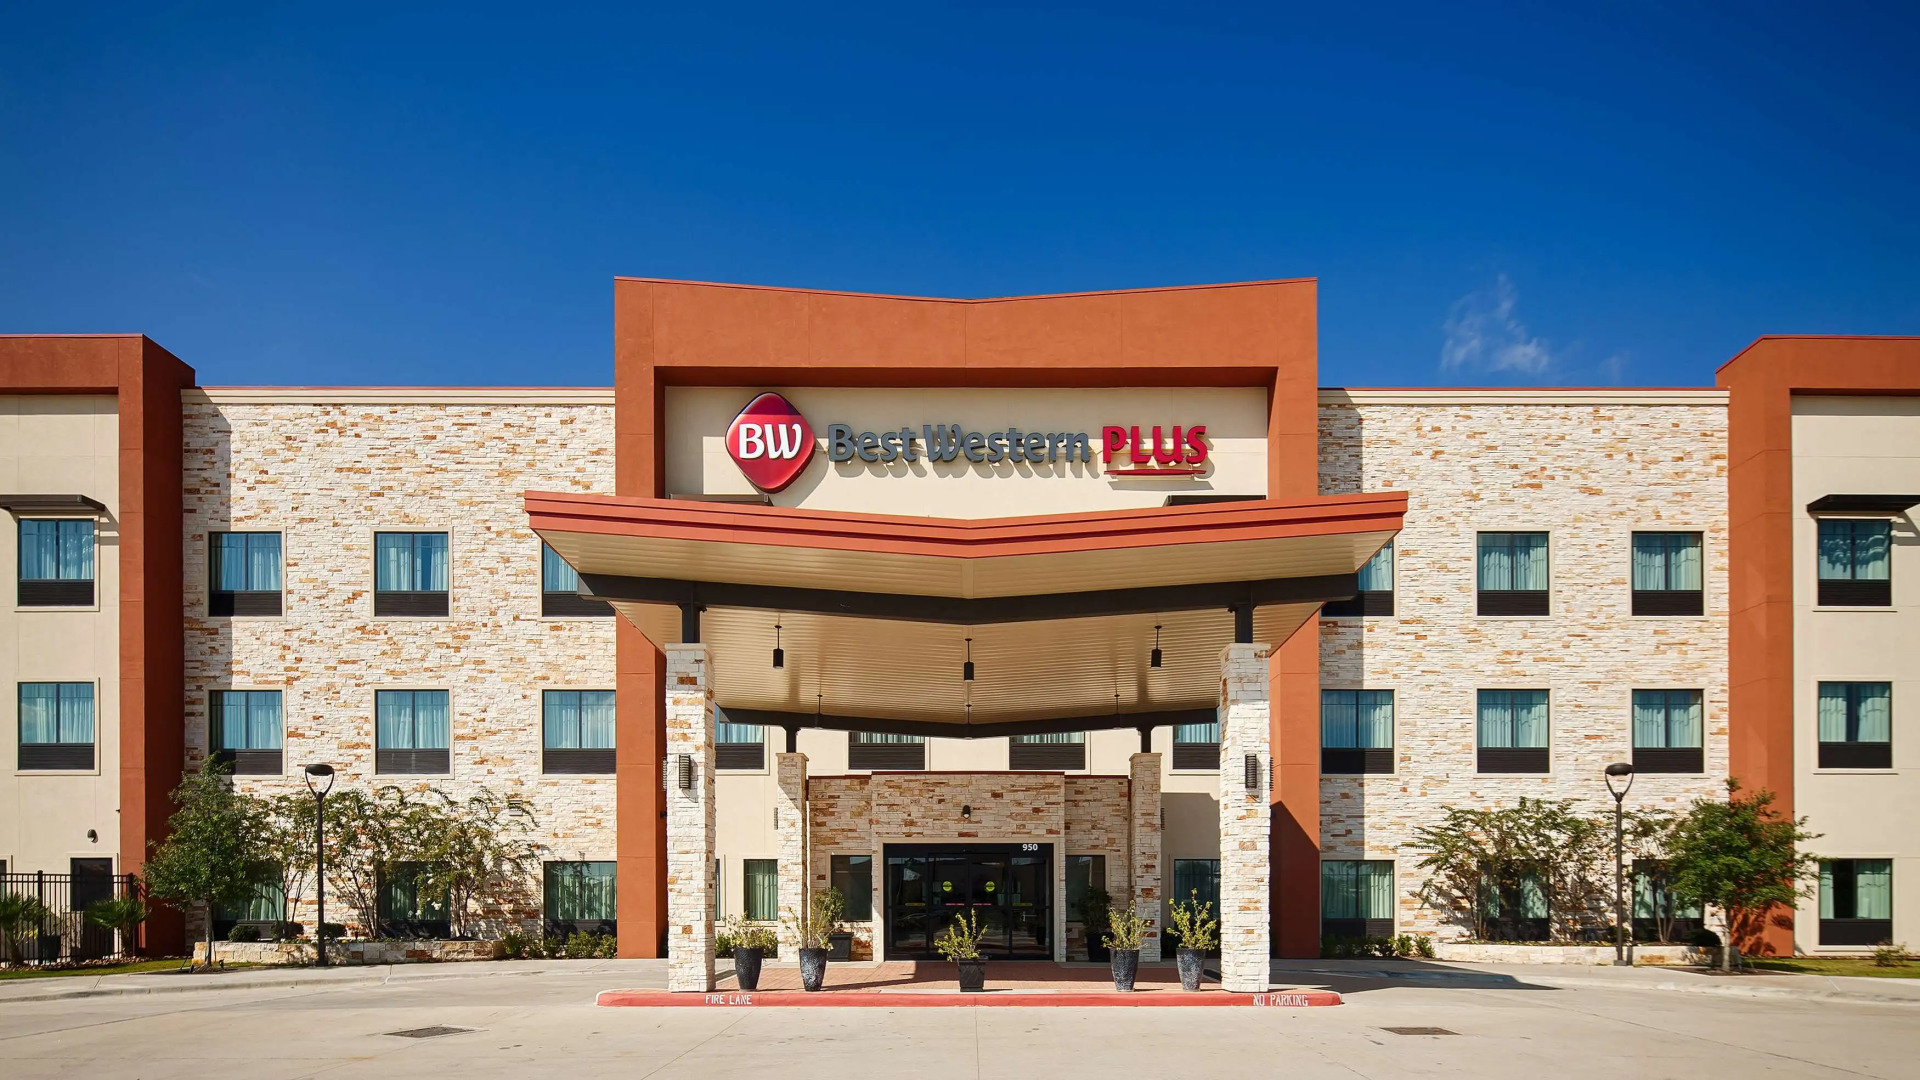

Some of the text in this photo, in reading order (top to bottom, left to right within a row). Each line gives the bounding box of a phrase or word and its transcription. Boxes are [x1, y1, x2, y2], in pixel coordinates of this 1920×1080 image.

[738, 423, 803, 460] BW
[828, 423, 1207, 464] Best Western PLUS
[1022, 843, 1038, 851] 950
[705, 994, 752, 1005] FIRE LANE
[1253, 994, 1308, 1006] NO PARKING
